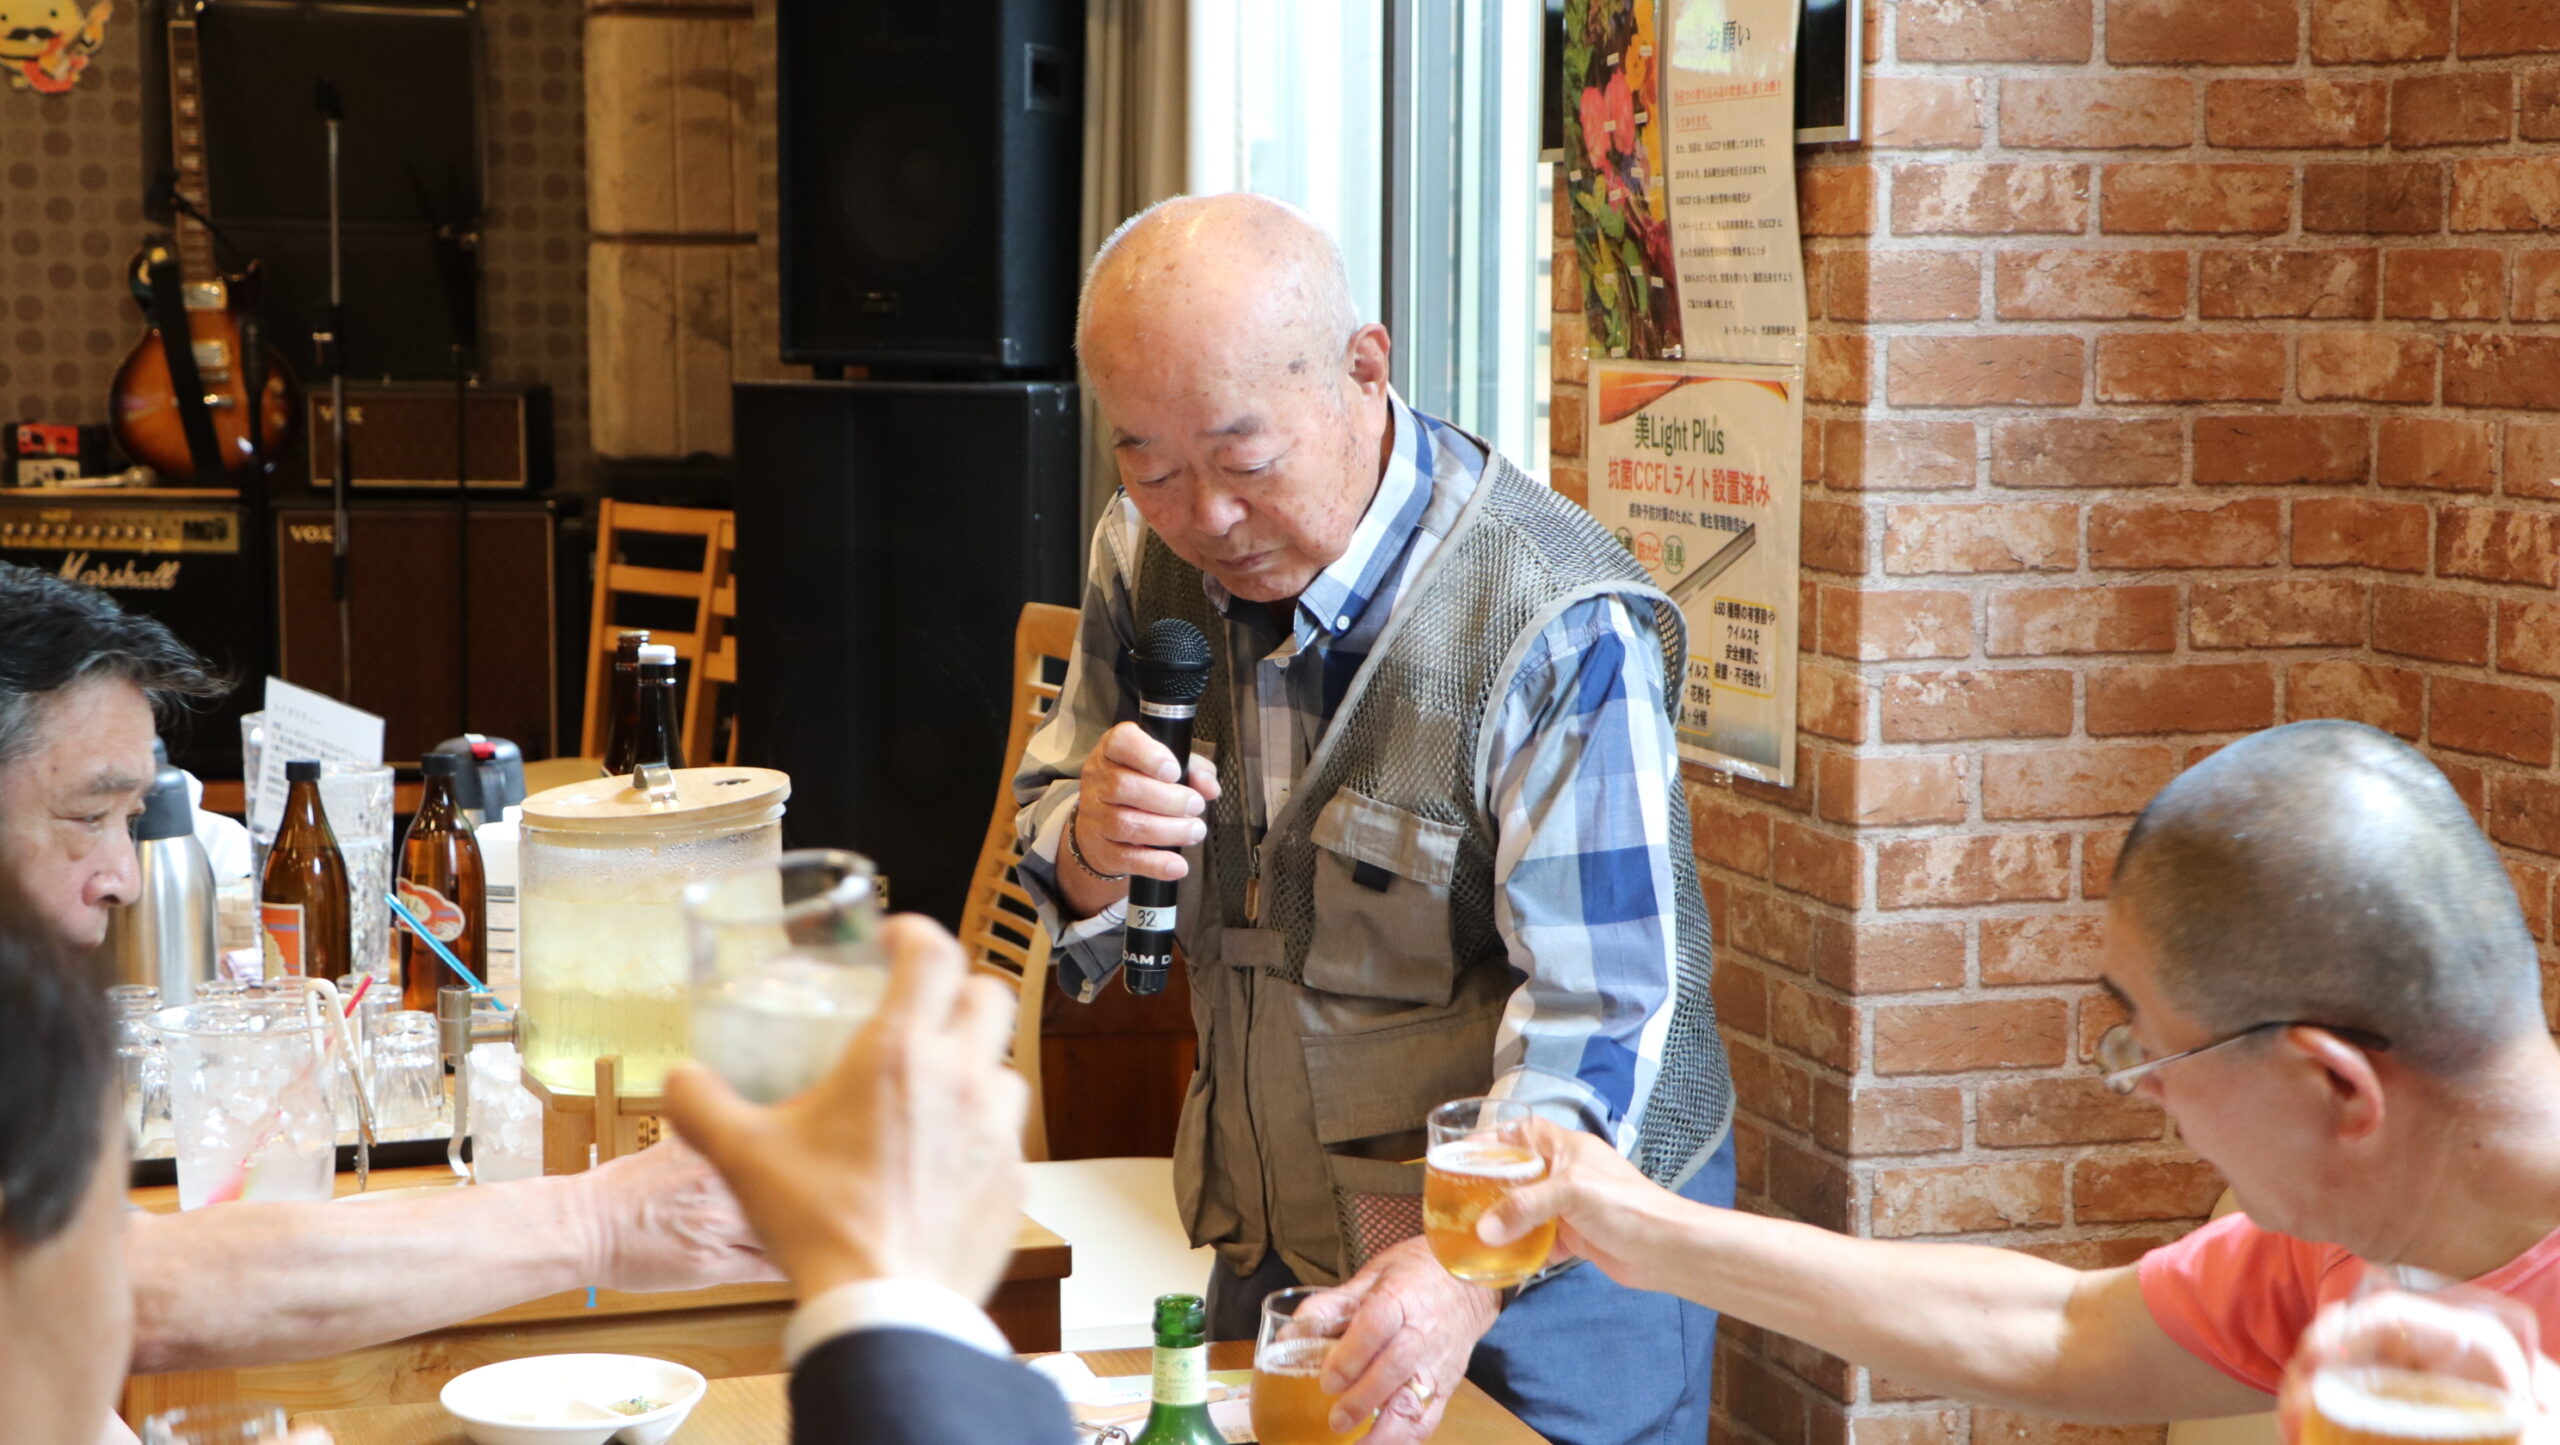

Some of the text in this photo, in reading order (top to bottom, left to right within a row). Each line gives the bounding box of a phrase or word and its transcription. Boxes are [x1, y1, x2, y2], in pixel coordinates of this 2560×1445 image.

[1706, 20, 1751, 53] お願い
[319, 405, 363, 424] VX
[1634, 412, 1724, 457] 美Light Plus
[1607, 456, 1770, 508] 抗菌CCFLライト設置済み
[290, 525, 333, 543] VOX
[58, 551, 181, 590] Marshall
[1726, 624, 1759, 645] ウイルスを
[1725, 644, 1758, 664] 安全無害に
[1137, 909, 1157, 927] 32
